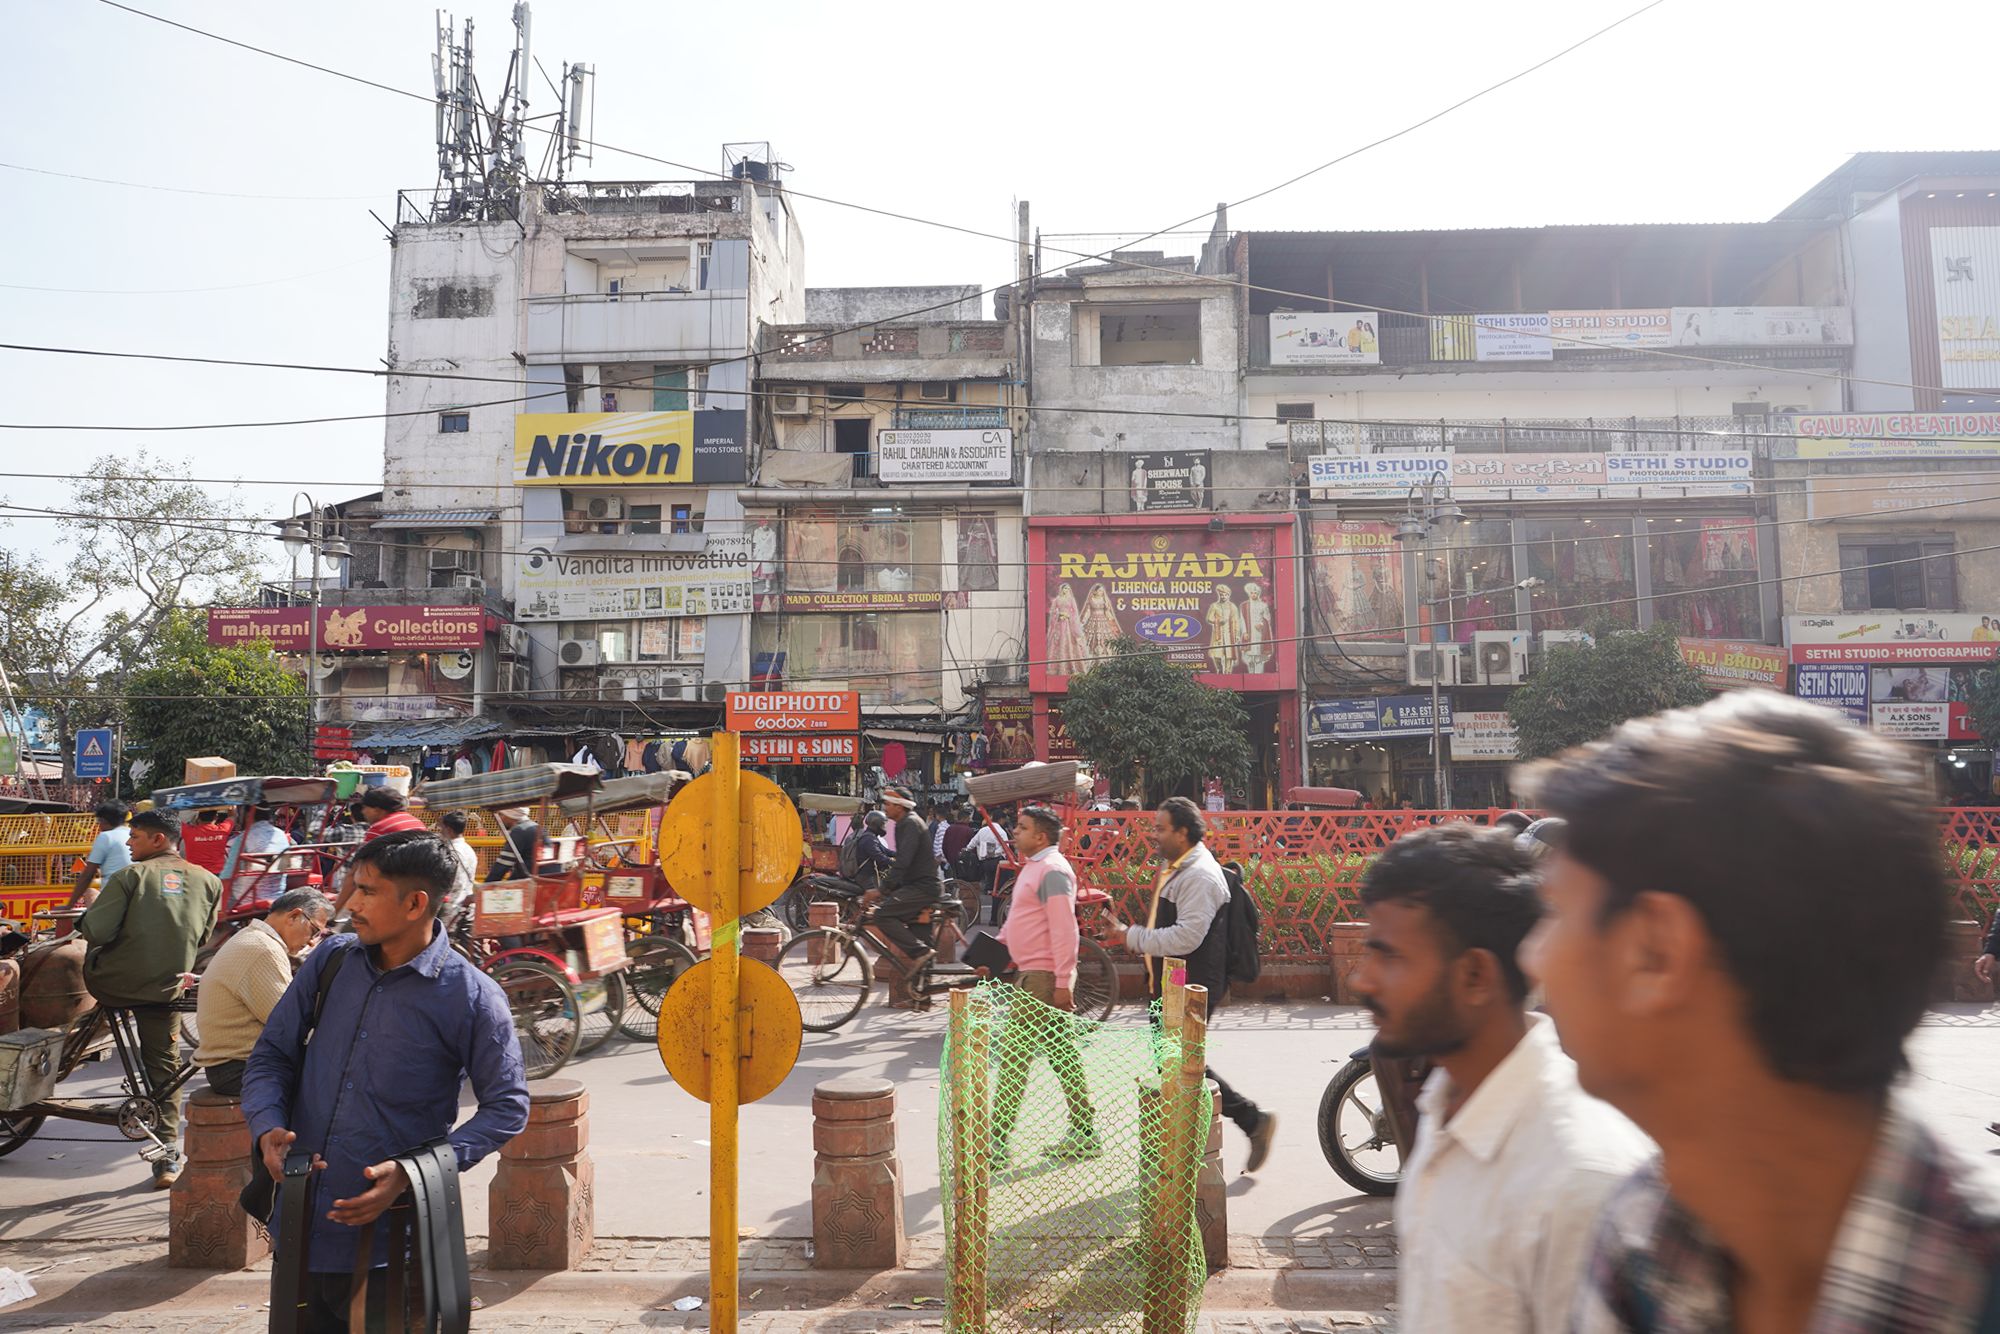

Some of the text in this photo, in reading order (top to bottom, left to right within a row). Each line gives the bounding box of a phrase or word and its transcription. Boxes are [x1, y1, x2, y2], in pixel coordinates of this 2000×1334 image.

[1477, 317, 1548, 328] SETHI STUDIO
[1551, 315, 1668, 328] SETHI STUDIO
[1799, 415, 1882, 437] GAURVI
[525, 433, 681, 476] Nikon
[882, 446, 1007, 460] RAHUL CHAUHAN & ASSOCIATE
[901, 460, 989, 470] CHARTERED ACCOUNTANT
[1312, 461, 1370, 475] SETHI
[1375, 459, 1449, 472] STUDIO
[1608, 456, 1749, 470] SETHI STUDIO
[1147, 468, 1190, 479] SHERWANI
[1315, 472, 1406, 482] PHOTOGRAPHIC
[1154, 479, 1182, 489] HOUSE
[1872, 498, 1912, 508] SETHI
[1342, 533, 1395, 546] BRIDAL
[556, 554, 634, 576] Vandita
[1059, 552, 1263, 579] RAJWADA
[605, 577, 636, 585] Frames
[658, 573, 710, 583] Sublimation
[1111, 581, 1213, 594] LEHENGA HOUSE
[786, 592, 941, 605] NAND COLLECTION BRIDAL STUDIO
[1116, 597, 1200, 611] & SHERWANI
[222, 620, 310, 636] maharani
[374, 619, 478, 635] Collections
[1141, 621, 1158, 629] SHOP
[1157, 617, 1189, 638] 42
[1806, 646, 1992, 659] SETHI STUDIO PHOTOGRAPHIC
[1686, 649, 1784, 673] TAJ BRIDAL
[1742, 670, 1776, 682] HOUSE
[1799, 671, 1866, 696] SETHI STUDIO
[733, 694, 841, 711] DIGIPHOTO
[1845, 697, 1864, 706] STORE
[1347, 711, 1376, 720] INTERNATIONAL
[1399, 705, 1449, 717] B.P.S. ESTTES
[1473, 713, 1499, 721] NEW
[1400, 717, 1425, 726] PRIVATE
[1454, 721, 1498, 730] HEARING
[750, 738, 853, 754] SETHI & SONS
